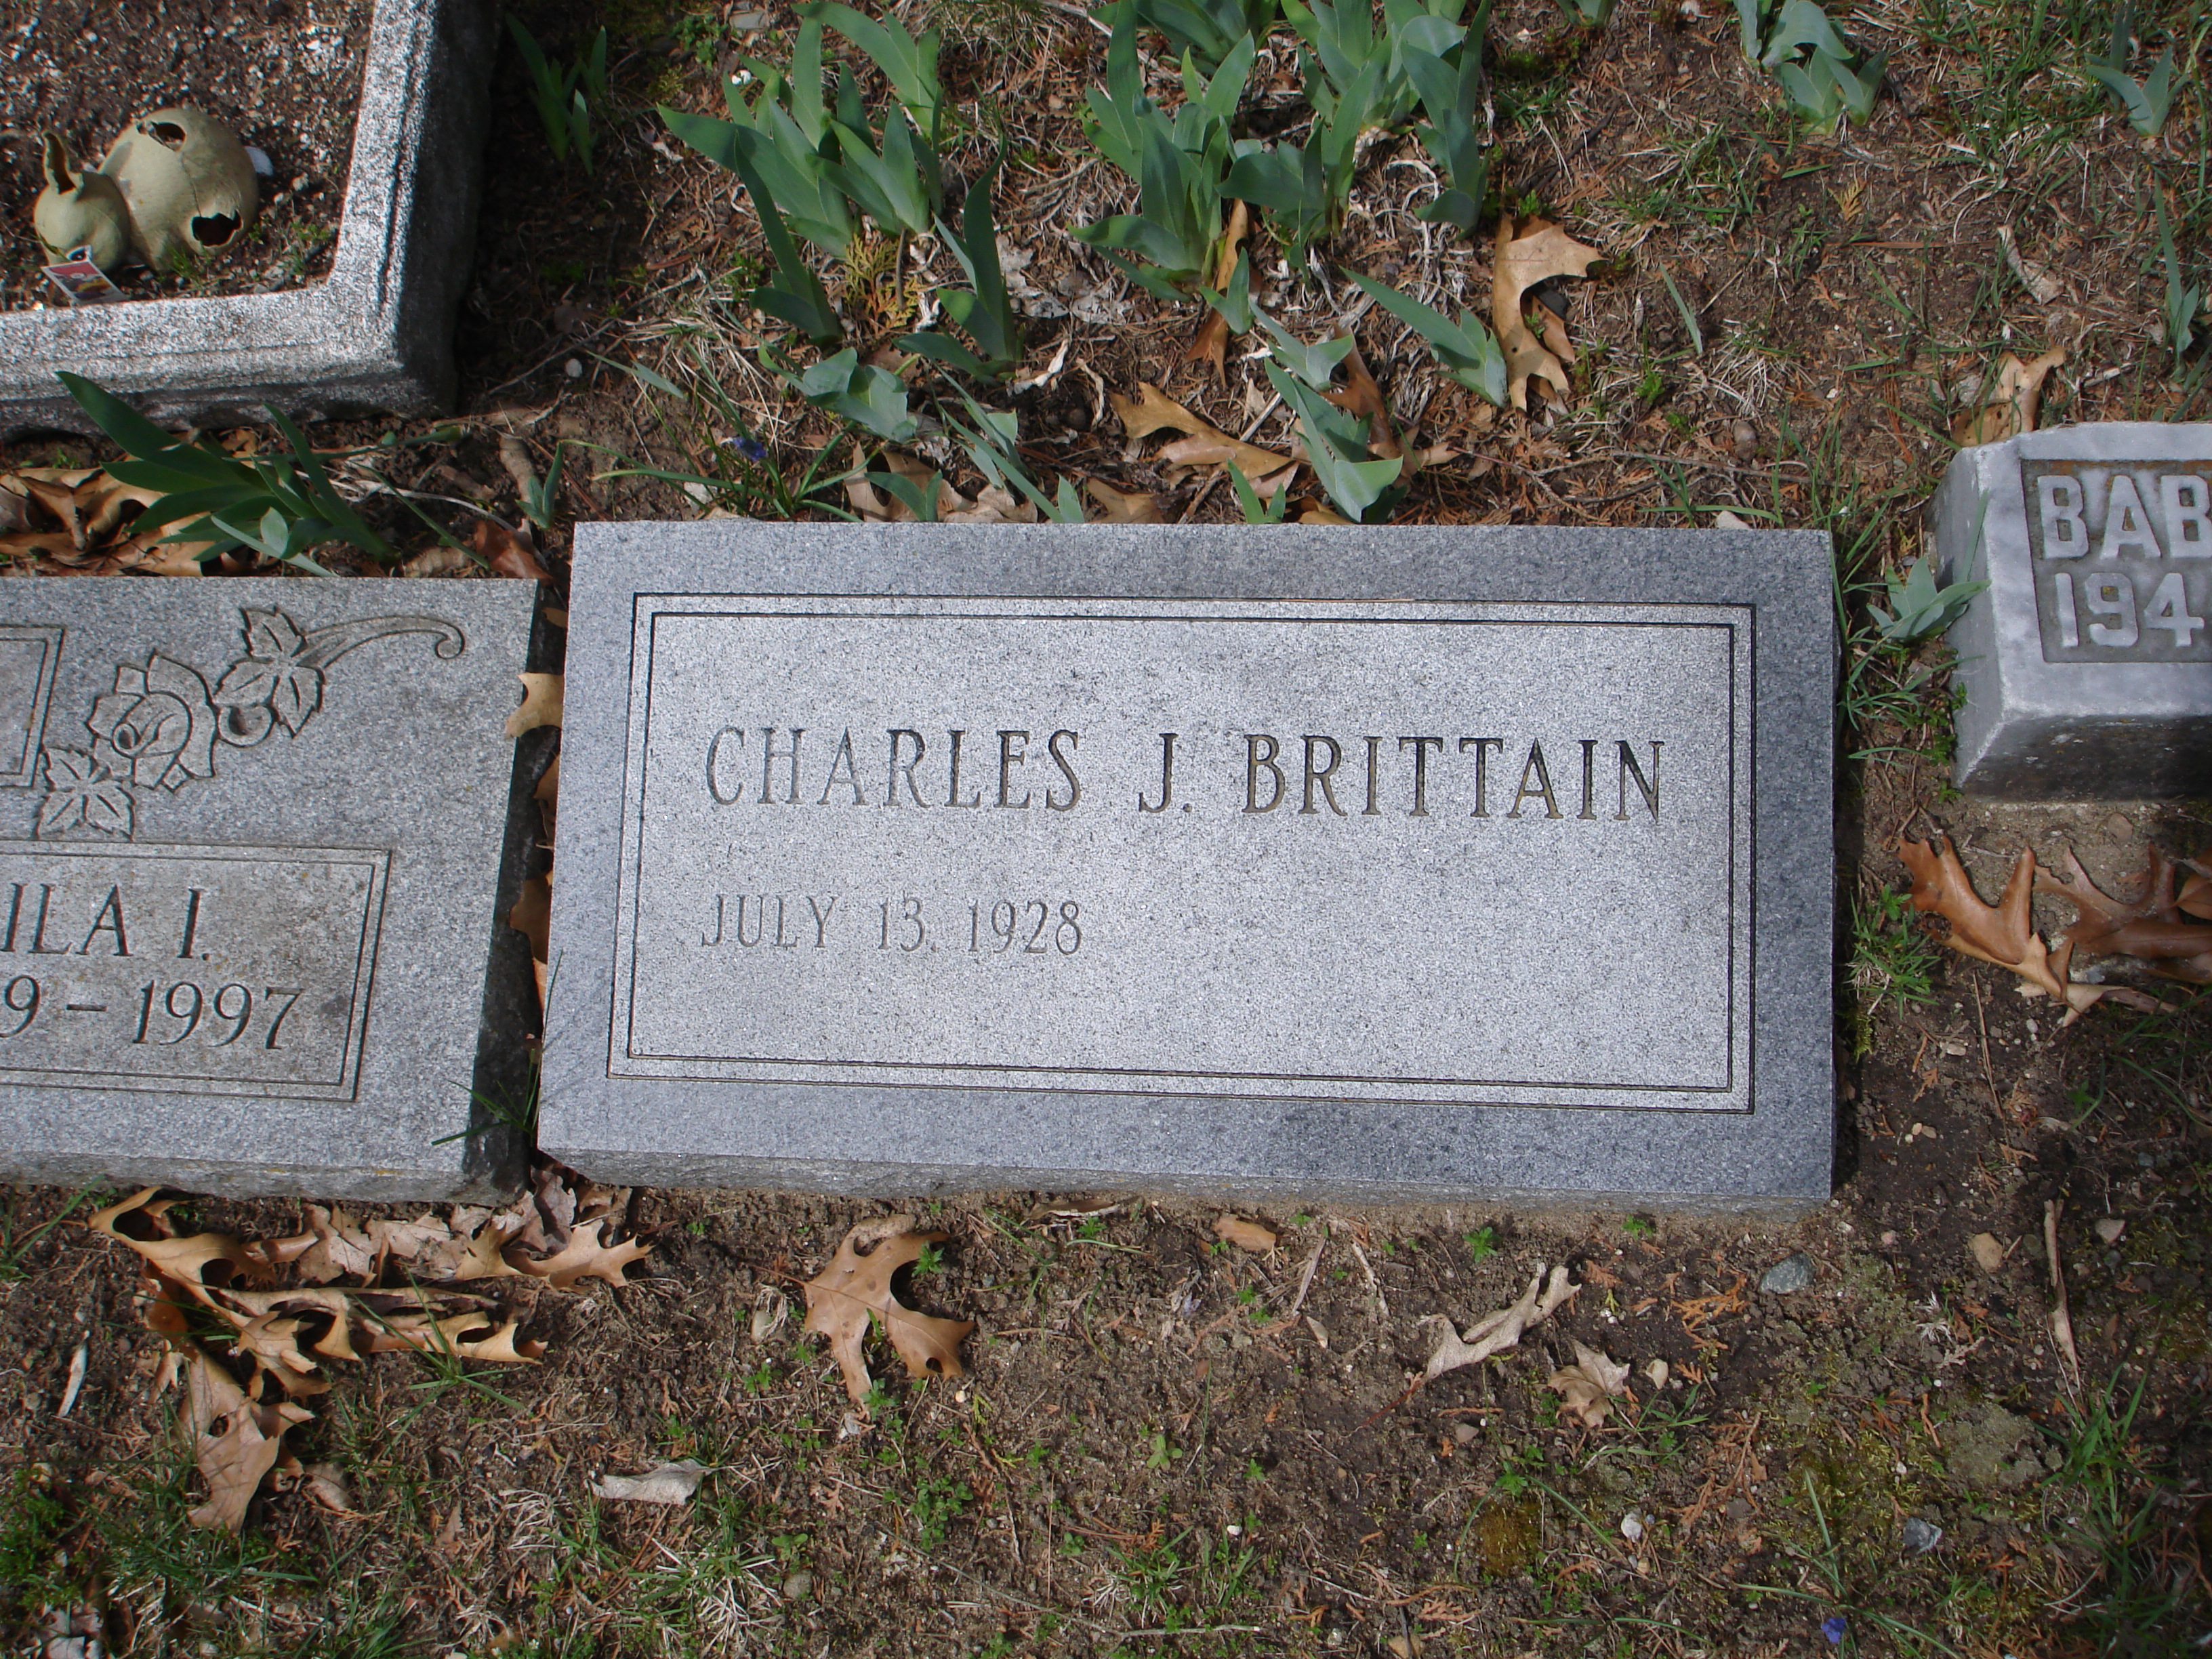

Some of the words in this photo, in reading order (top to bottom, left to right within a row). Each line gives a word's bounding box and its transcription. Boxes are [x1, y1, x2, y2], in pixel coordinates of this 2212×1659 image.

[2037, 475, 2212, 559] BAB
[2054, 572, 2205, 647] 194
[705, 725, 1081, 812] CHARLES
[1139, 733, 1193, 813] J.
[1242, 734, 1665, 823] BRITTAIN
[0, 882, 134, 957] ILA
[178, 888, 210, 960] I.
[701, 894, 840, 948] JULY
[968, 899, 1082, 956] 1928
[0, 975, 40, 1038] 9
[133, 980, 305, 1050] 1997
